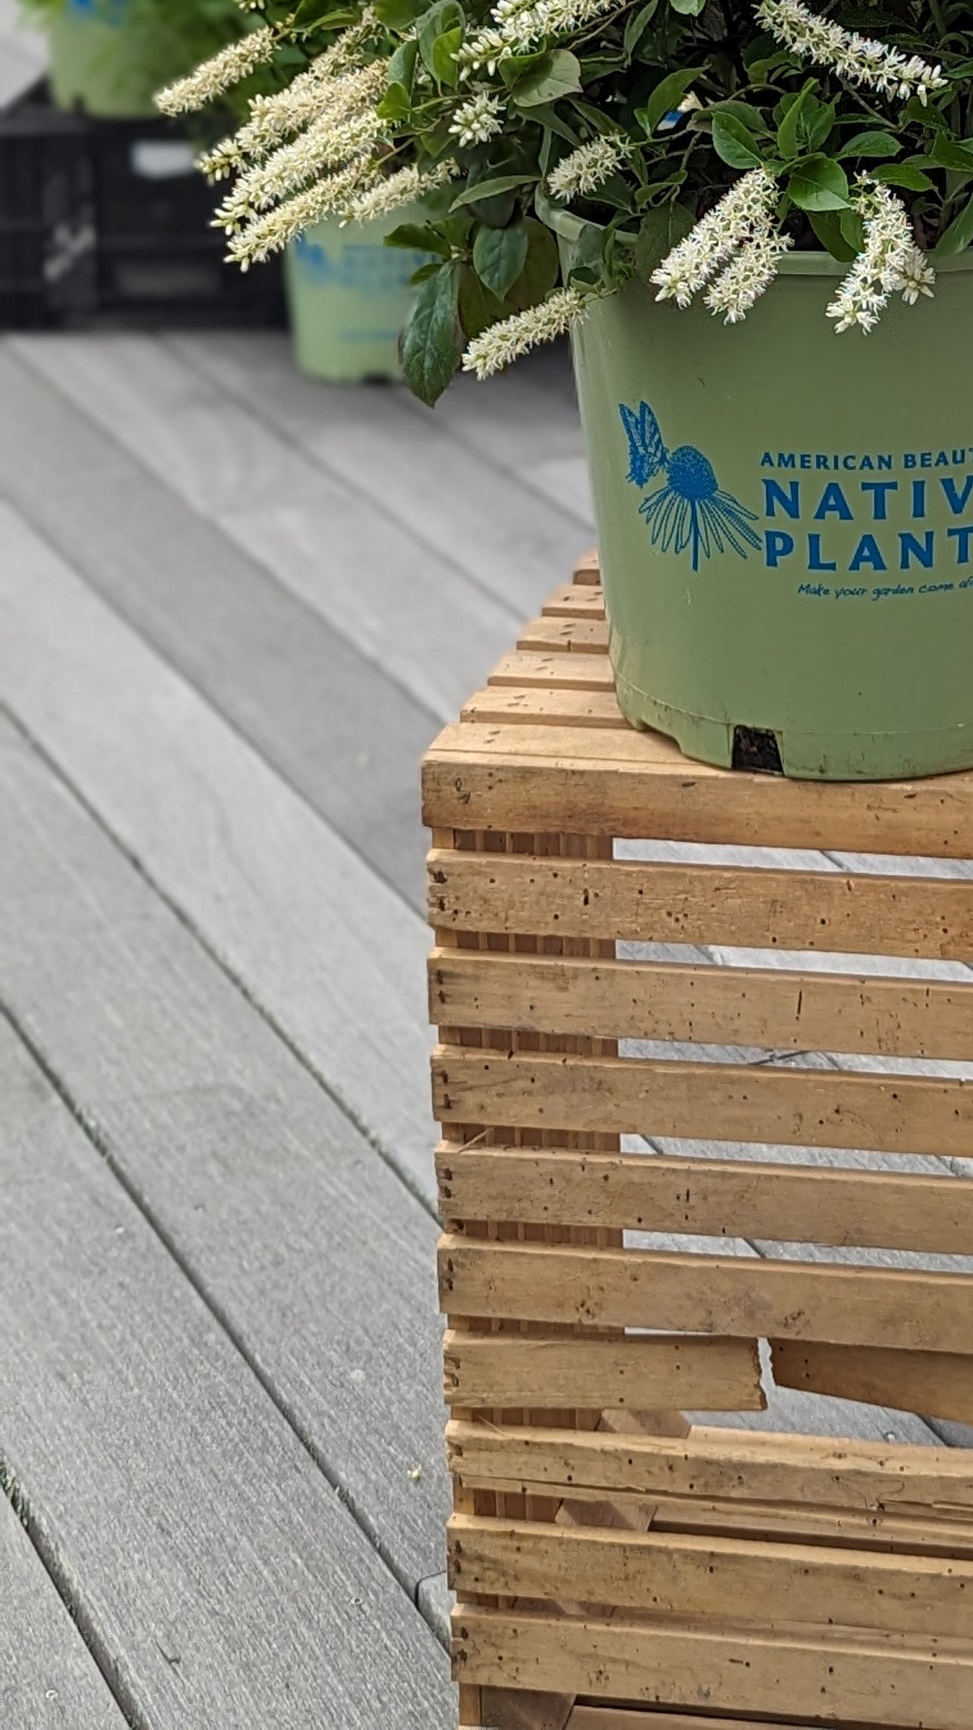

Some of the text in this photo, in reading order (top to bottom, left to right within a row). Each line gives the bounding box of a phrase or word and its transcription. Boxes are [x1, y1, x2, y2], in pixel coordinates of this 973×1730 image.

[760, 451, 893, 470] AMERICAN
[798, 583, 831, 597] Make
[834, 587, 868, 599] your
[872, 584, 915, 602] garden
[918, 581, 954, 594] come
